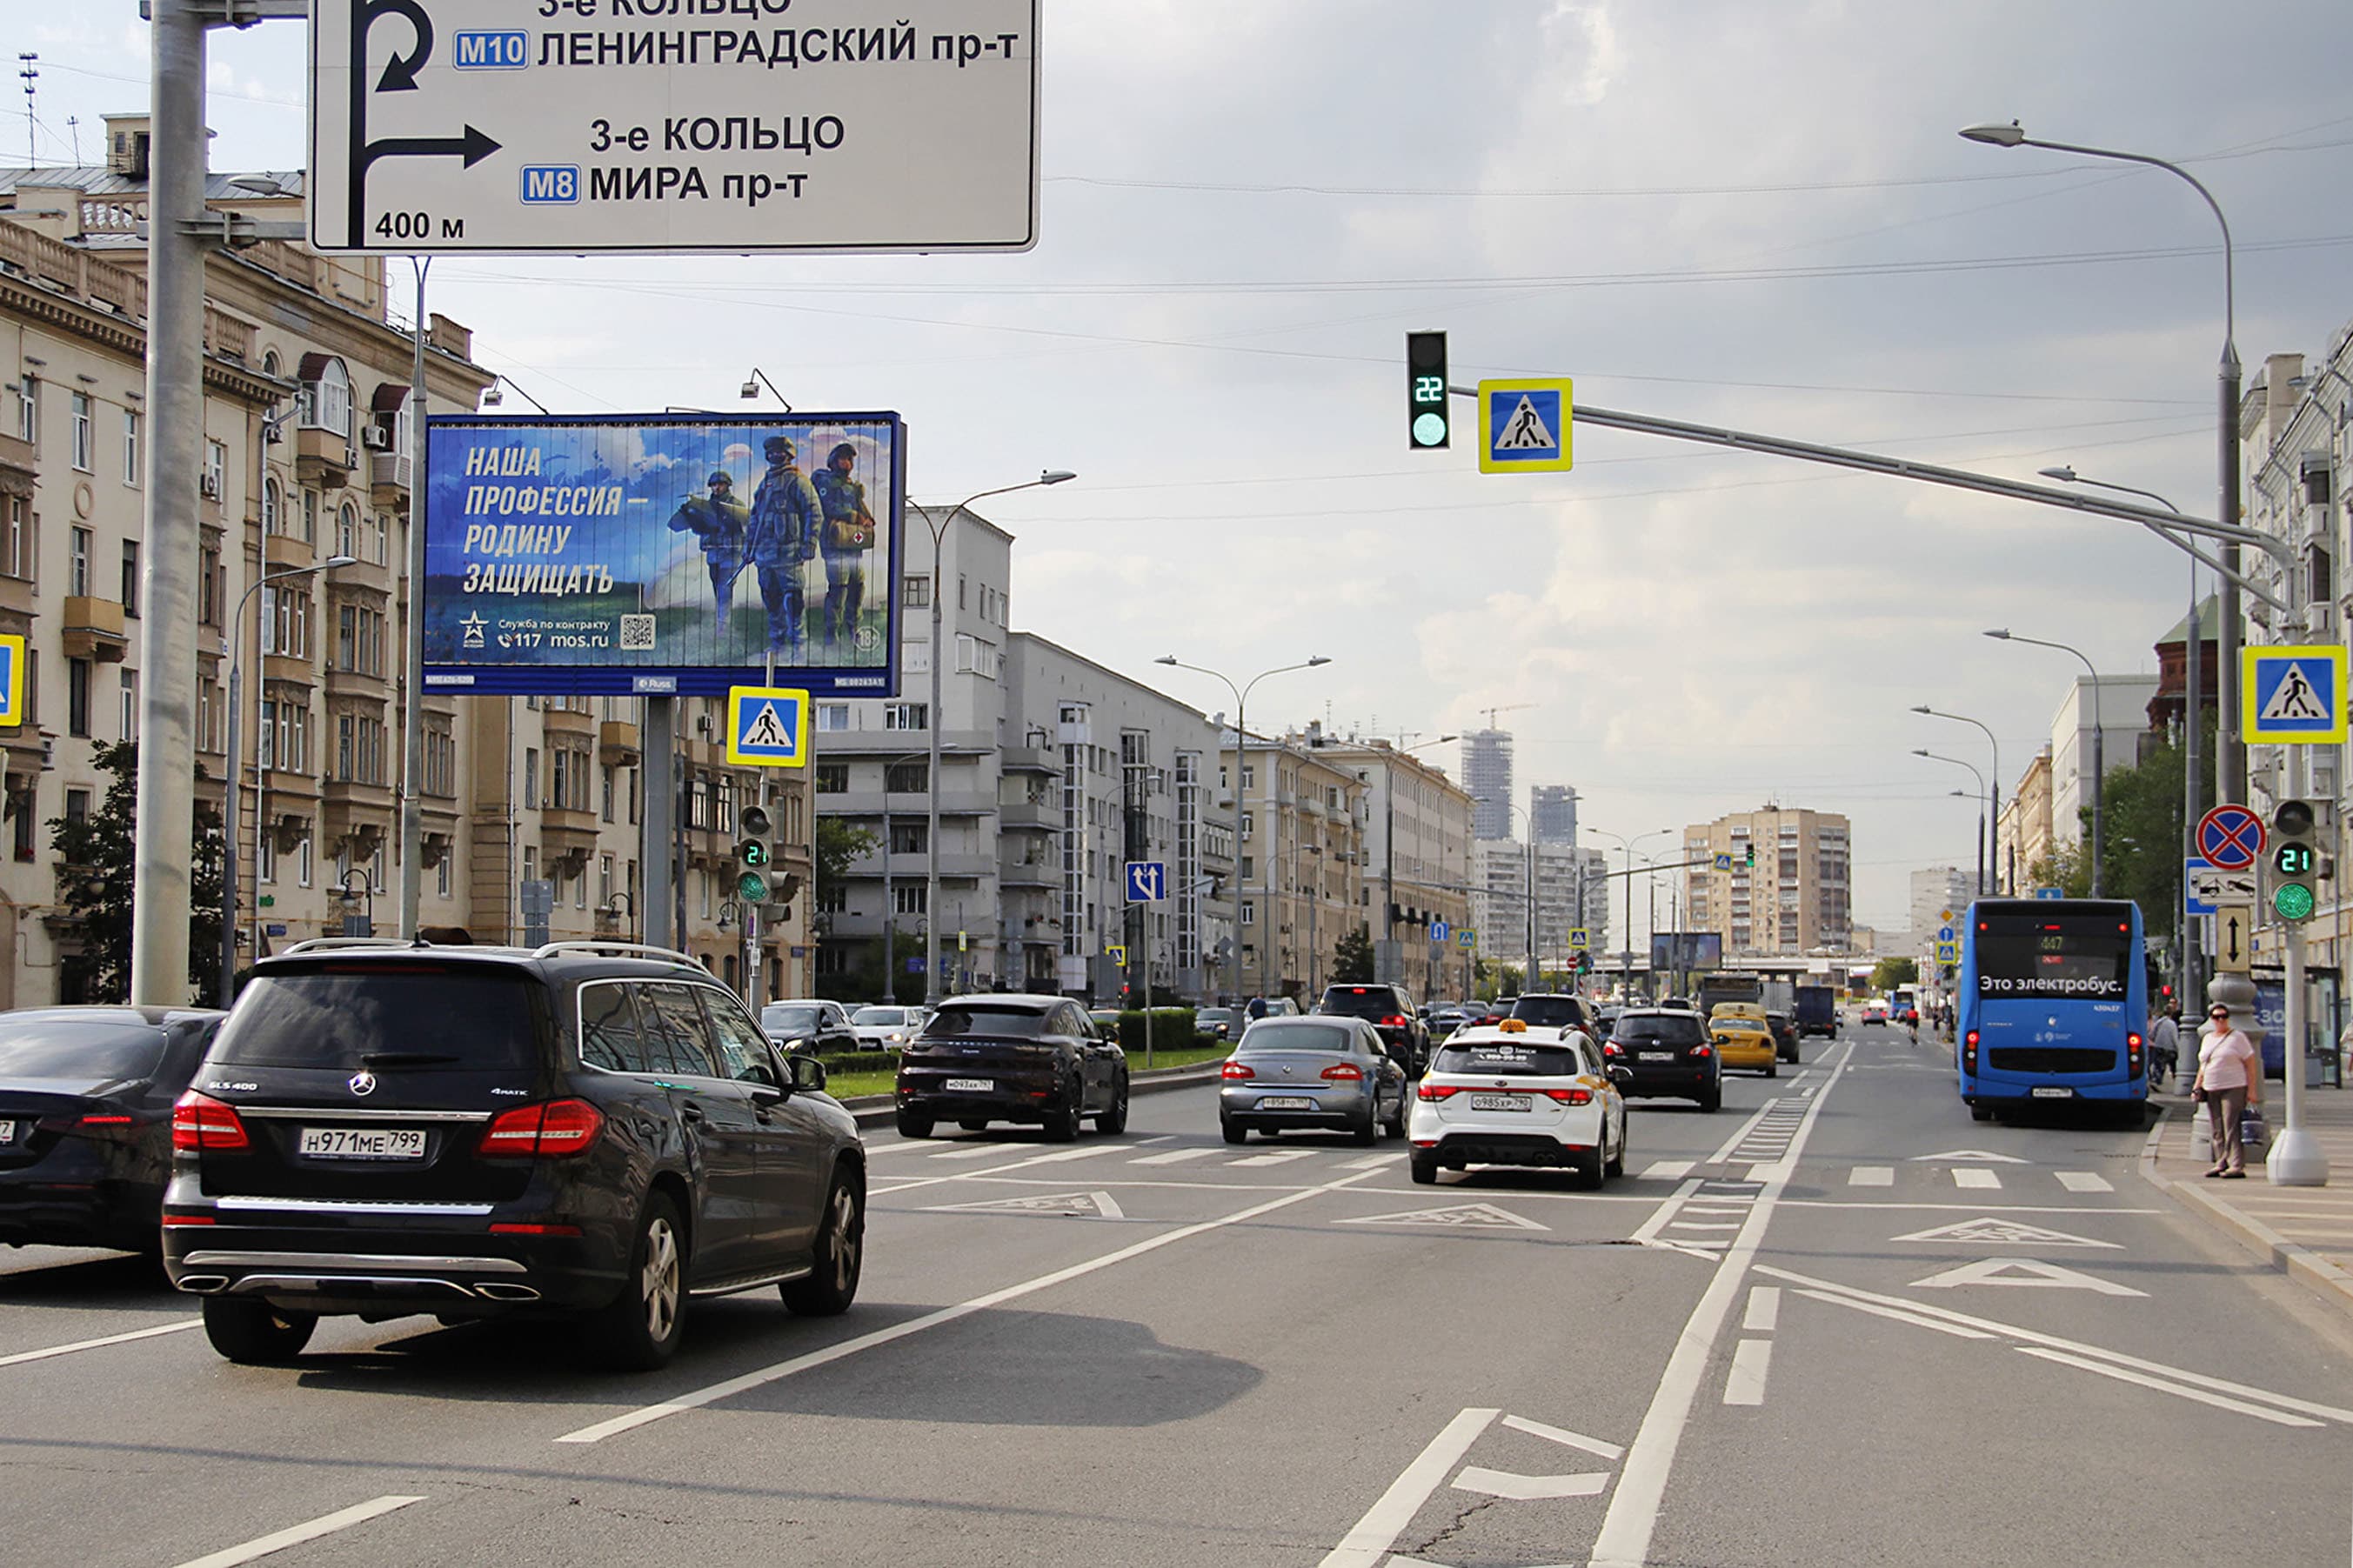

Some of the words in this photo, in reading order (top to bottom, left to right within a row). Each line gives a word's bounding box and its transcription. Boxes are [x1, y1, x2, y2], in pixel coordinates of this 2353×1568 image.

[538, 19, 916, 70] ЛЕНИНГРАДСКИЙ
[932, 33, 1019, 68] пр-т
[590, 118, 650, 152] 3-е
[664, 116, 845, 156] КОЛЬЦО
[590, 167, 708, 200] МИРА
[722, 174, 808, 207] пр-т
[374, 211, 430, 239] 400
[442, 217, 465, 238] м
[1414, 377, 1442, 402] 22
[465, 447, 541, 477] НАША
[465, 485, 623, 516] ПРОФЕССИЯ
[463, 524, 572, 557] РОДИНУ
[463, 564, 614, 597] ЗАЩИЩАТЬ
[498, 618, 538, 631] Служба
[556, 621, 611, 631] контракту
[514, 633, 542, 648] 117
[551, 635, 609, 648] mos.ru
[747, 845, 767, 864] 21
[2282, 849, 2310, 872] 21
[1980, 975, 2012, 991] Это
[2015, 976, 2123, 995] электробус.
[231, 1082, 258, 1091] 400
